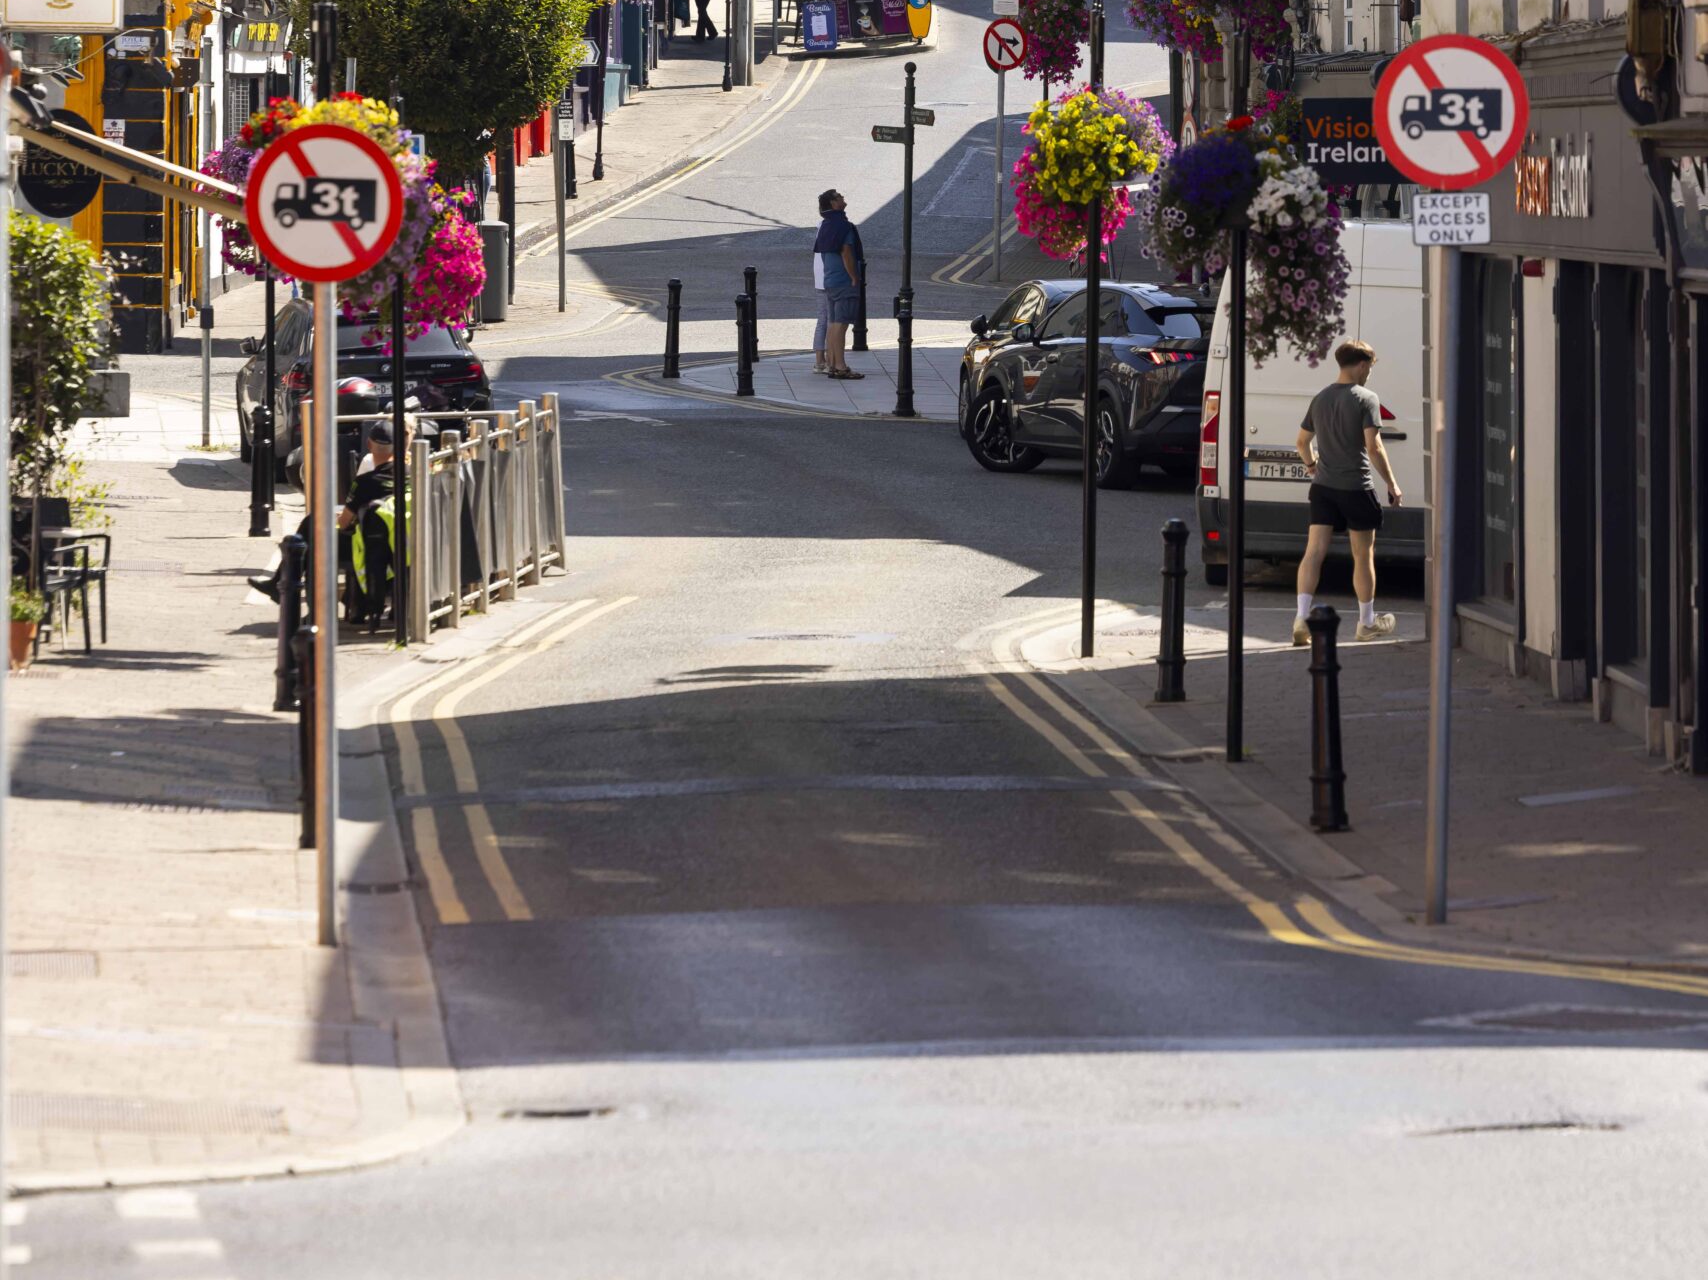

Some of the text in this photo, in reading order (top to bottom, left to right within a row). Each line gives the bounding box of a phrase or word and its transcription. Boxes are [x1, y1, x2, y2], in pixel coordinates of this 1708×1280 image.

[806, 4, 832, 13] Bonita
[1438, 93, 1485, 127] 3t
[1307, 141, 1386, 164] Irelan
[21, 162, 79, 177] LUCKY
[311, 181, 361, 218] 3t
[1419, 195, 1482, 210] EXCEPT
[1417, 211, 1486, 227] ACCESS
[1429, 229, 1475, 243] ONLY
